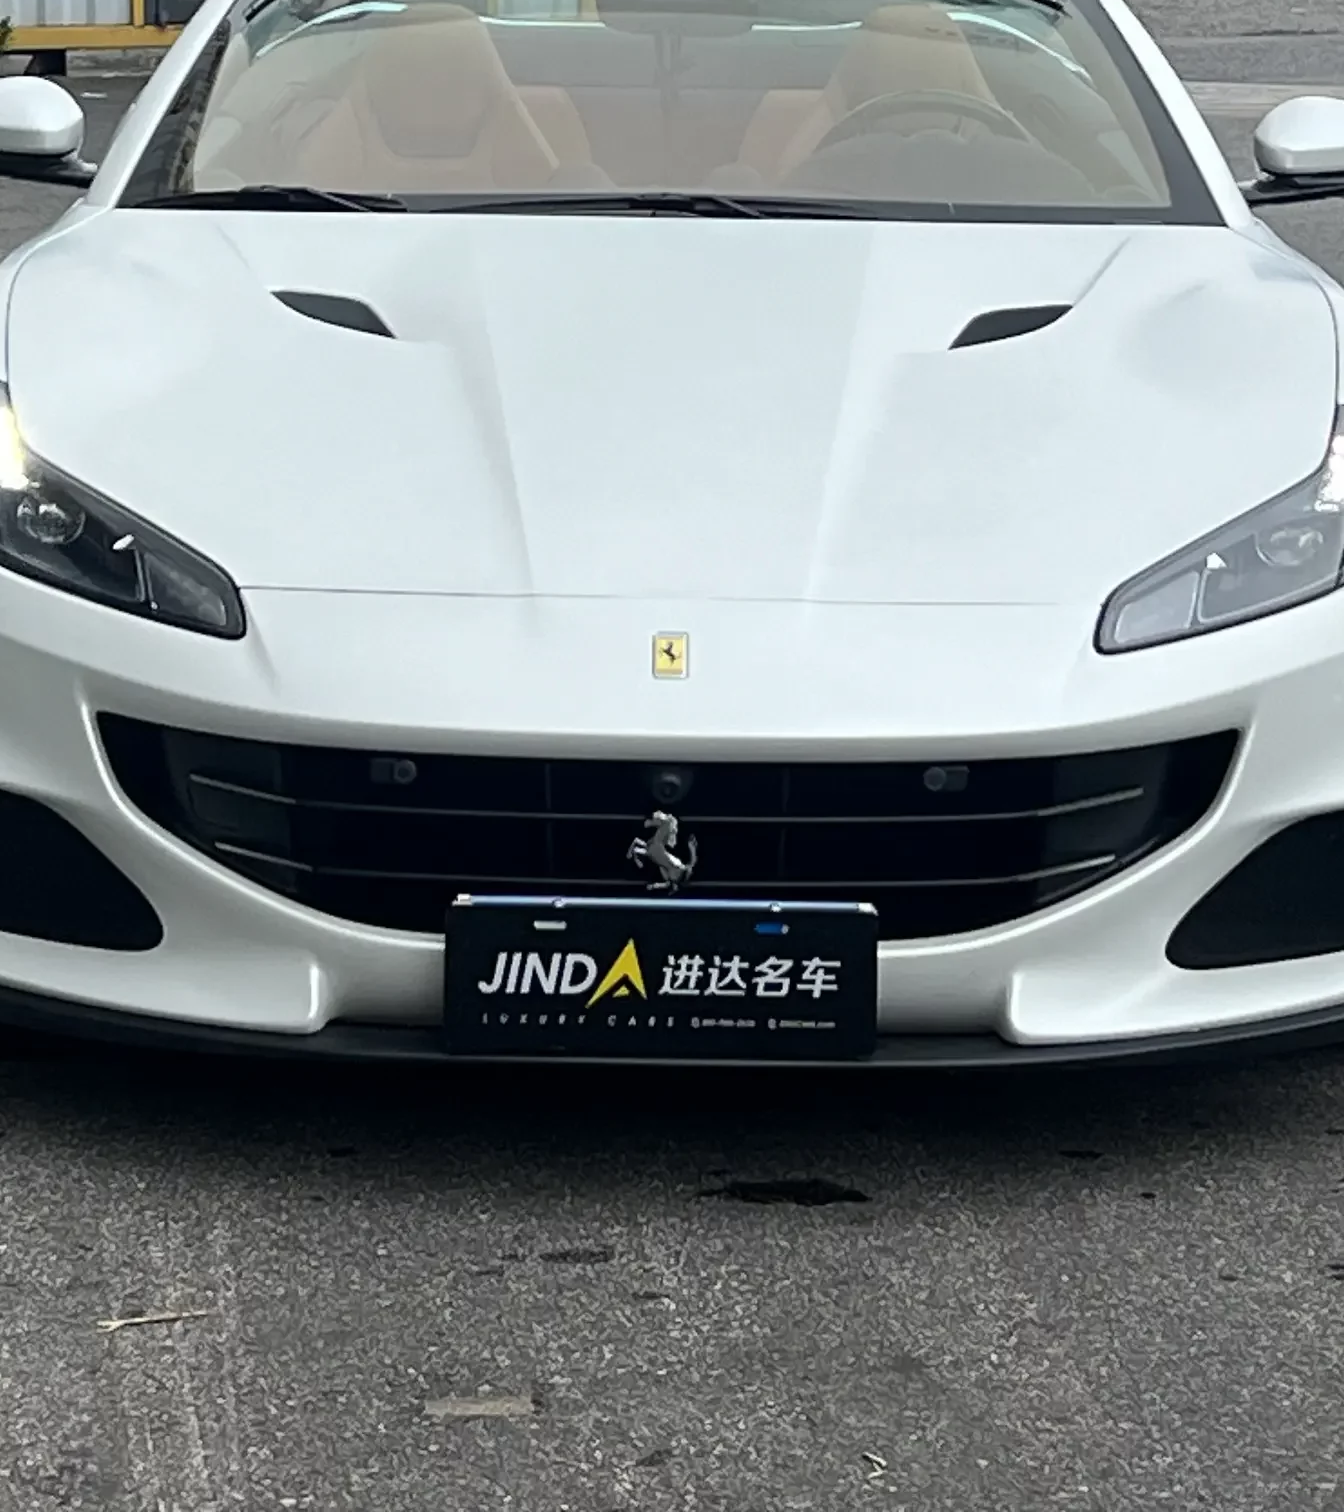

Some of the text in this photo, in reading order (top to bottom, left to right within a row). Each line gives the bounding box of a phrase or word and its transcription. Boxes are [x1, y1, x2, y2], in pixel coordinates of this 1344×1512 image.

[477, 938, 842, 1009] JINDA 进达名车
